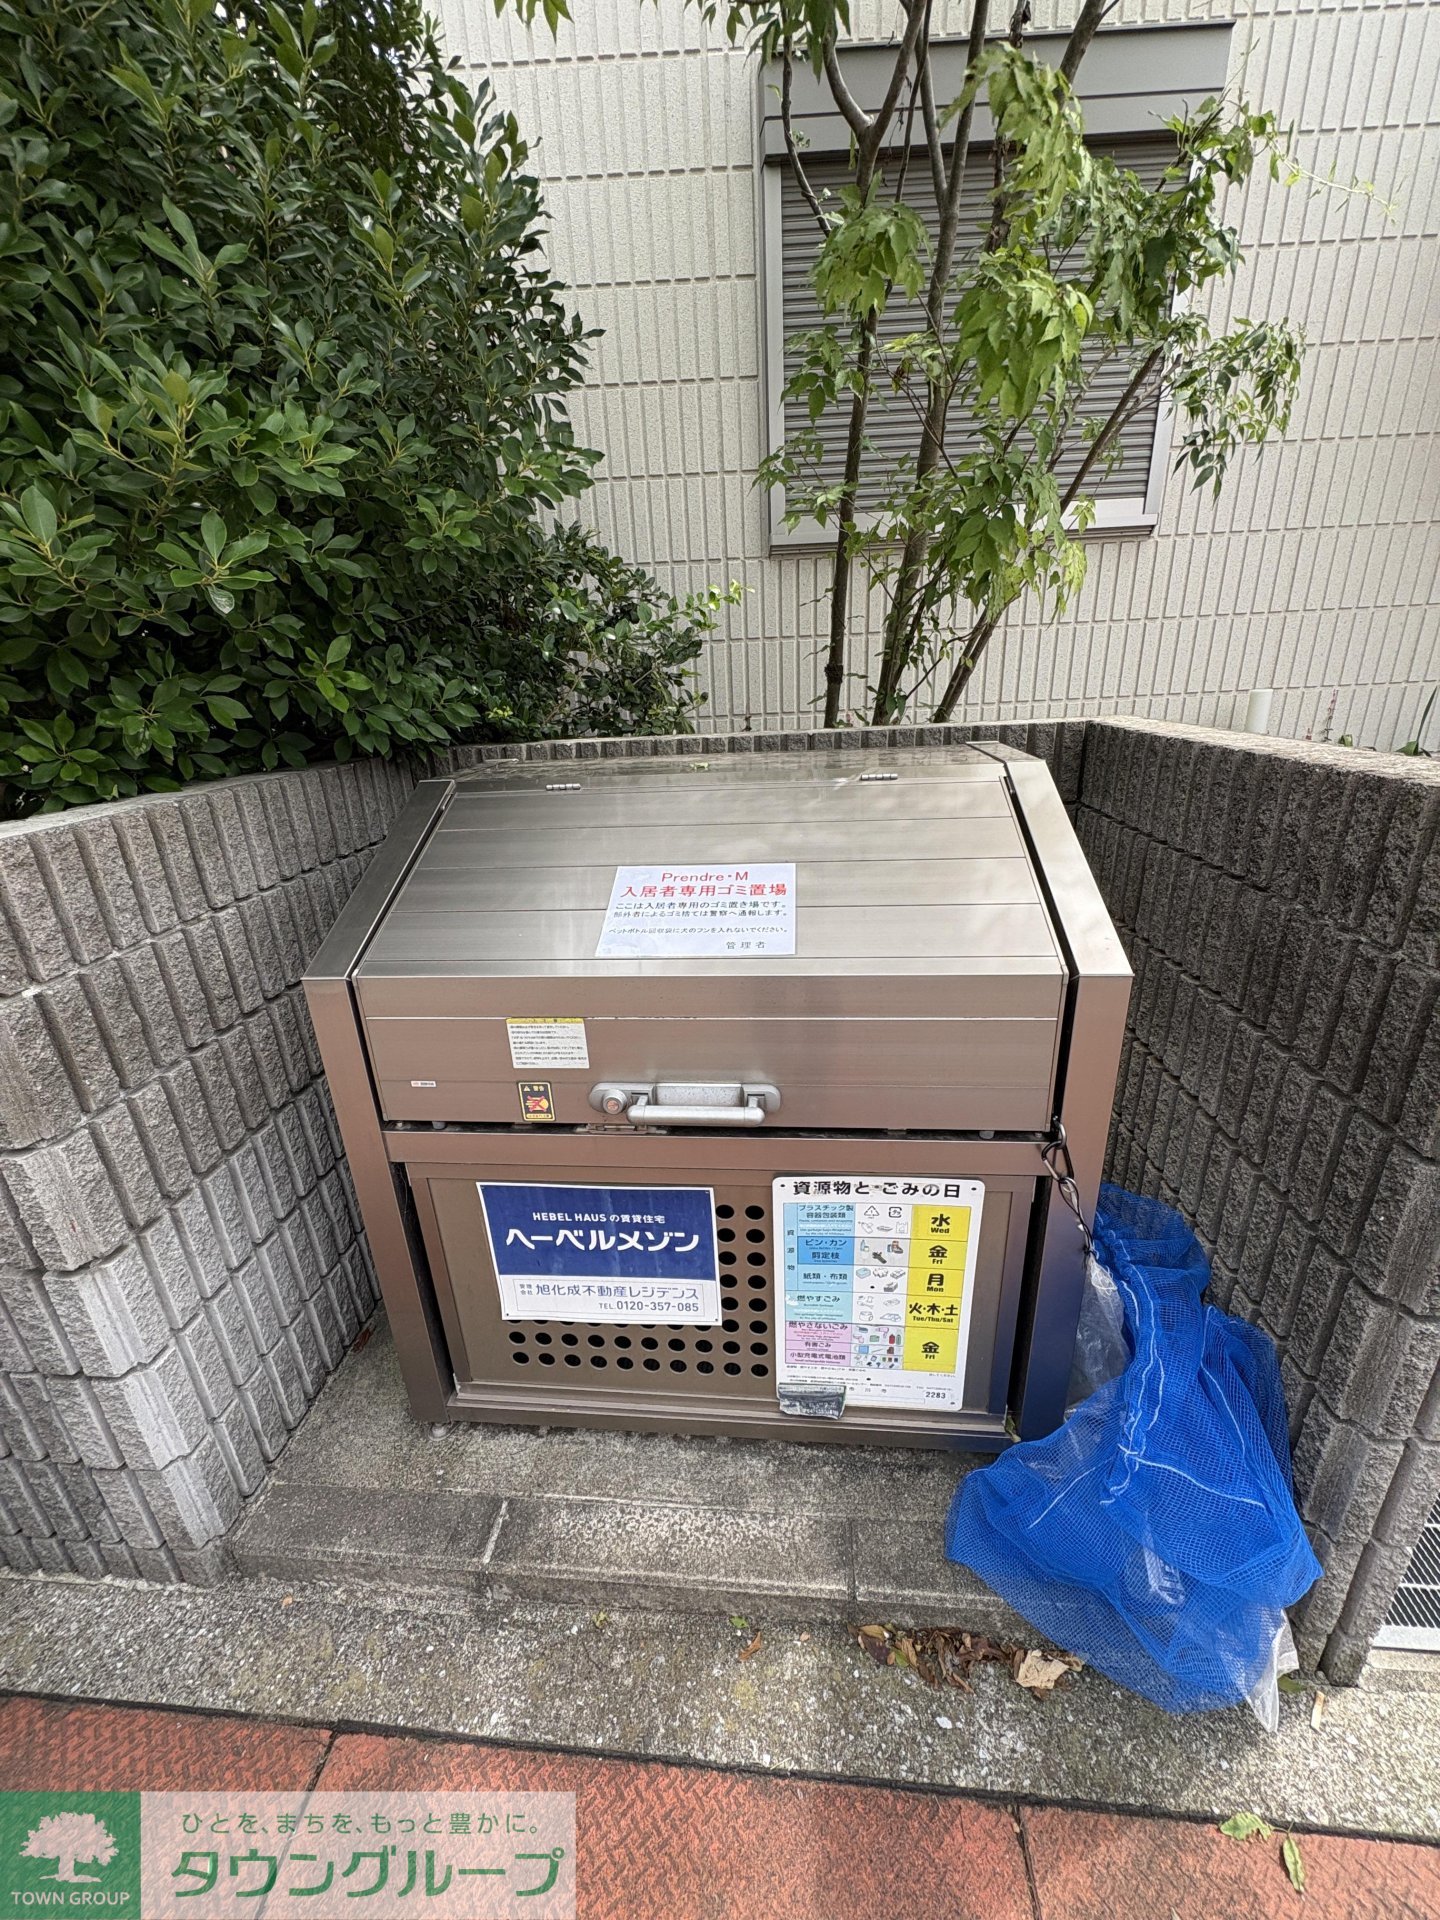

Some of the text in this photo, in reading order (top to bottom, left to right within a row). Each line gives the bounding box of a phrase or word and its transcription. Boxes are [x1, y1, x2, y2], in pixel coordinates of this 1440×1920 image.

[620, 883, 787, 898] 入居者専用ゴミ置場
[616, 900, 786, 910] ここは入居者専用のゴミ置き場です。
[613, 909, 787, 918] 部外者によるゴミ捨ては警察へ通報します。
[799, 1204, 854, 1212] プラスチック製
[533, 1211, 666, 1225] HEBEL HAUS の賃貸住宅
[931, 1213, 951, 1227] 水
[506, 1228, 699, 1252] ヘーベルメゾン
[805, 1239, 848, 1247] ビン・カン
[928, 1244, 948, 1258] 金
[928, 1273, 945, 1287] 月
[536, 1284, 699, 1300] 旭化成不動産レジデンス
[909, 1303, 959, 1316] 火・木・土
[912, 1315, 953, 1323] Tue/Thu/Sat
[921, 1341, 939, 1354] 金
[925, 1391, 946, 1399] 2283
